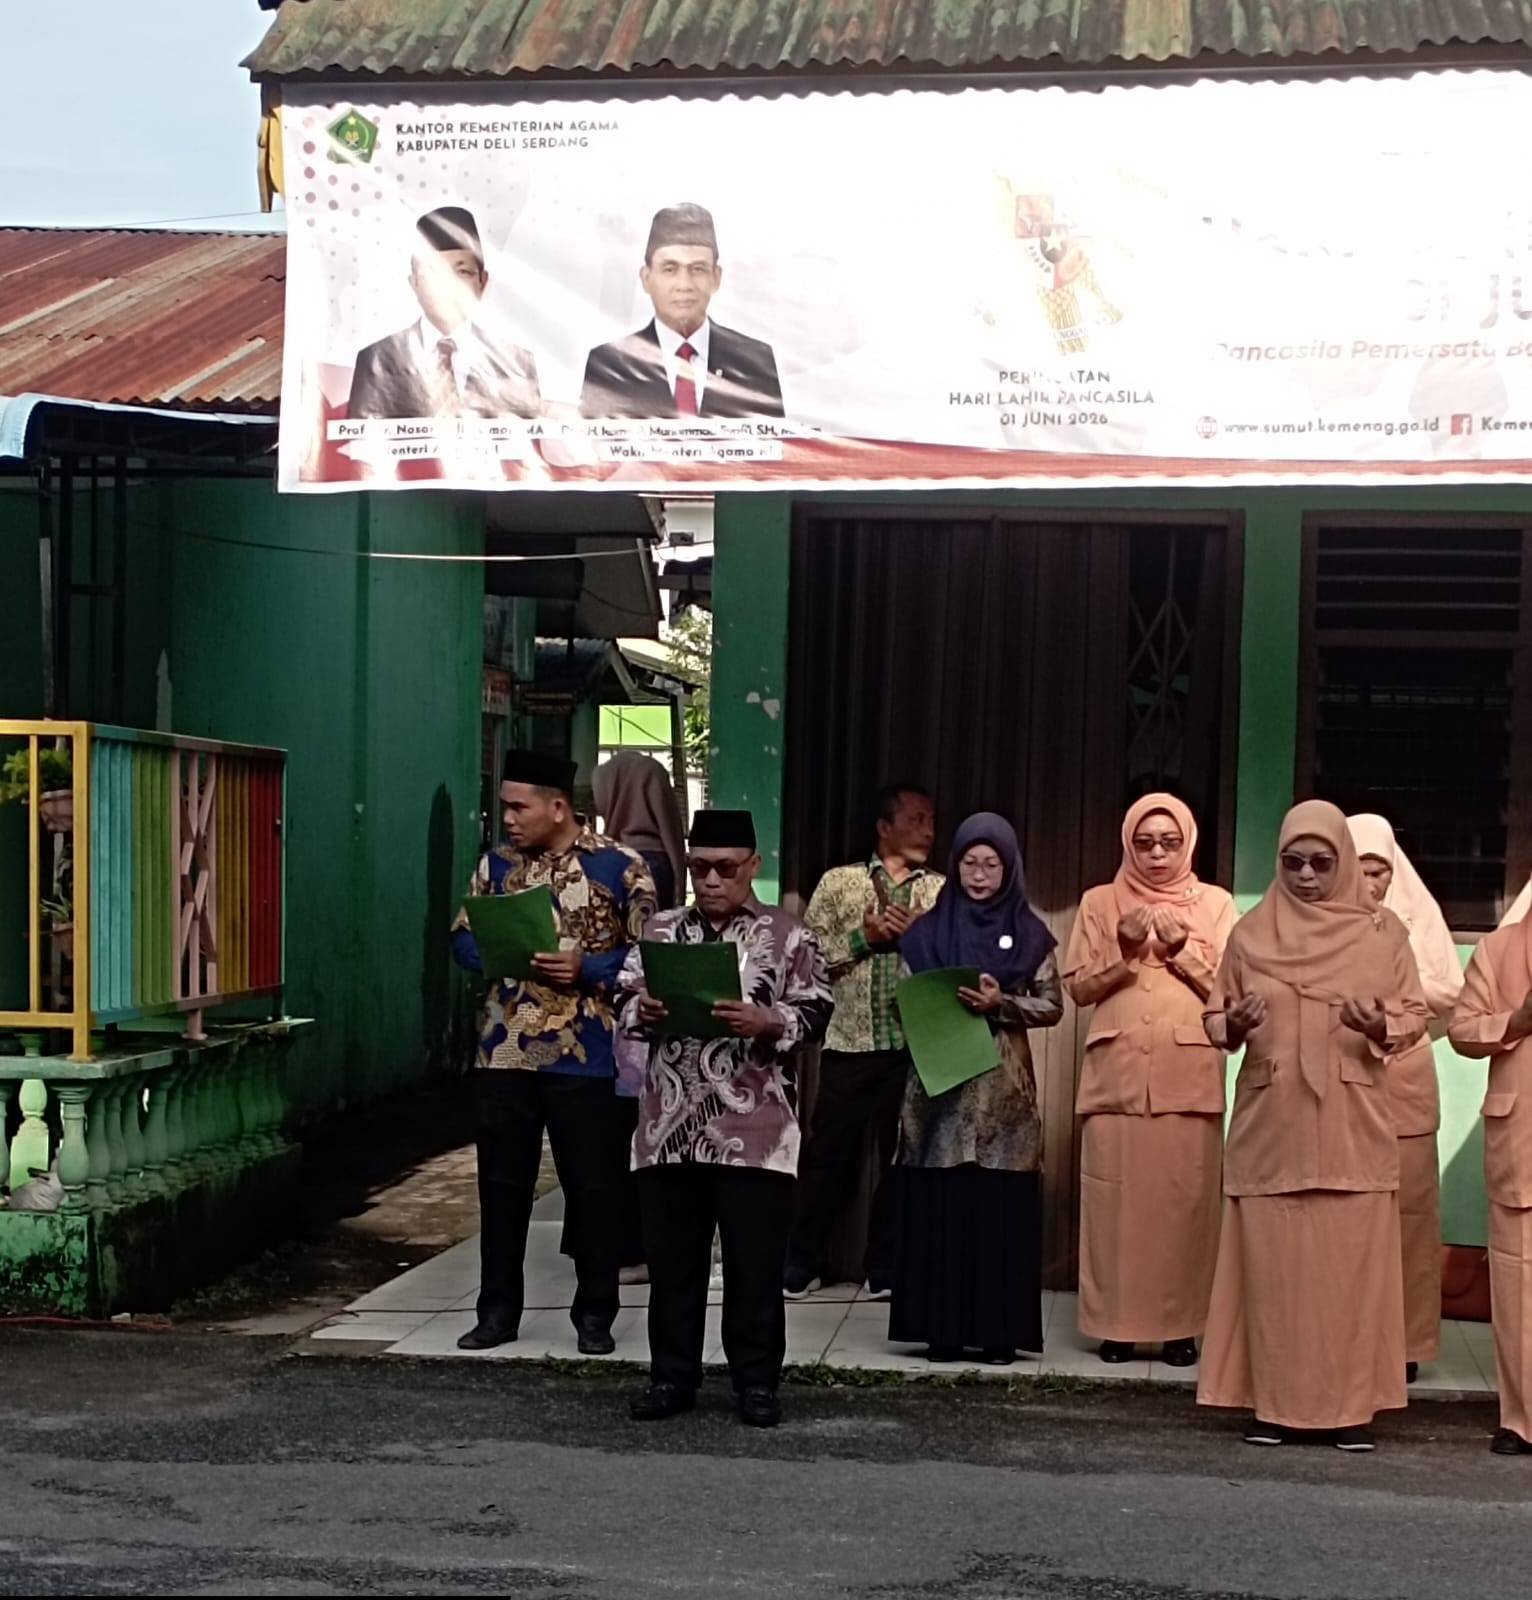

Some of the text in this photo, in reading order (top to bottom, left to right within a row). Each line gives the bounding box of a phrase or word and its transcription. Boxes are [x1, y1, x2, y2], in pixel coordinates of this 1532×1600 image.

[395, 120, 620, 135] KANTOR KEMENTERIAN AGAMA
[396, 136, 589, 152] KABUPATEN DELI SERDANG
[999, 368, 1111, 385] PERTAN
[949, 389, 1155, 406] HARI LAHIR PANCASILA
[1000, 411, 1109, 428] 01 JUNI 2026
[1224, 416, 1440, 436] www.sumut.kemenag.go.id
[386, 445, 428, 456] enteri
